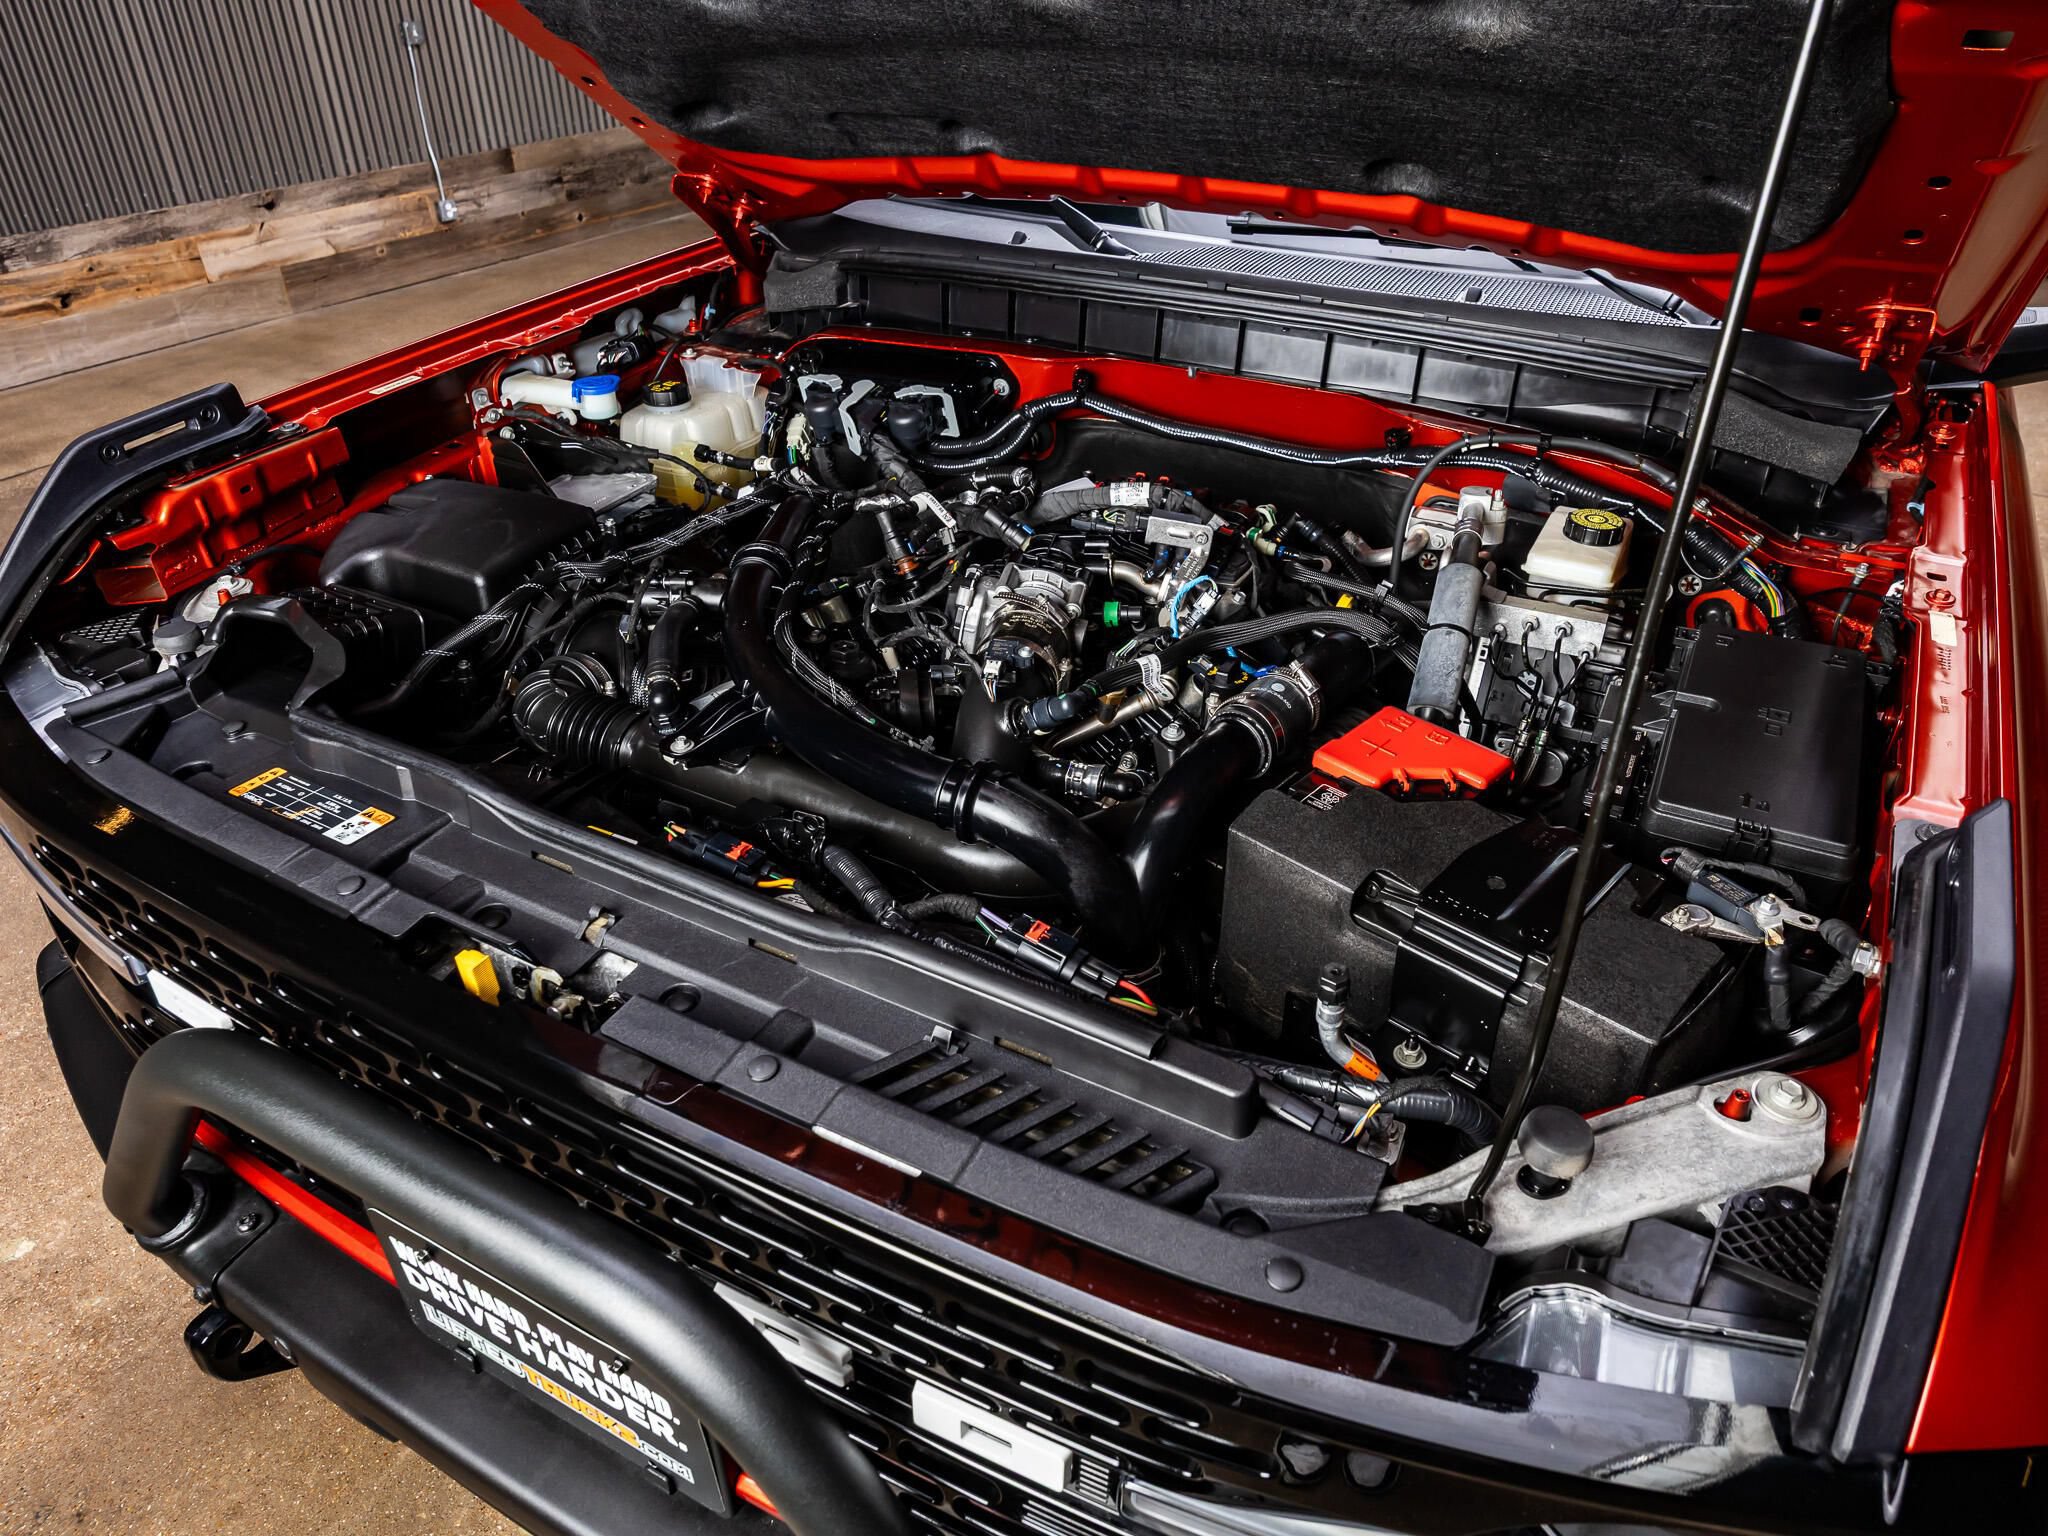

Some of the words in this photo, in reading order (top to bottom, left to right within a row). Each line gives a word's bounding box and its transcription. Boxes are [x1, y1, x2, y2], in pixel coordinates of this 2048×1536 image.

[400, 1261, 513, 1345] DRIVE
[514, 1329, 689, 1453] HARDER.
[462, 1279, 539, 1339] HARD.
[536, 1322, 595, 1374] PLAY
[598, 1359, 681, 1426] HARD.
